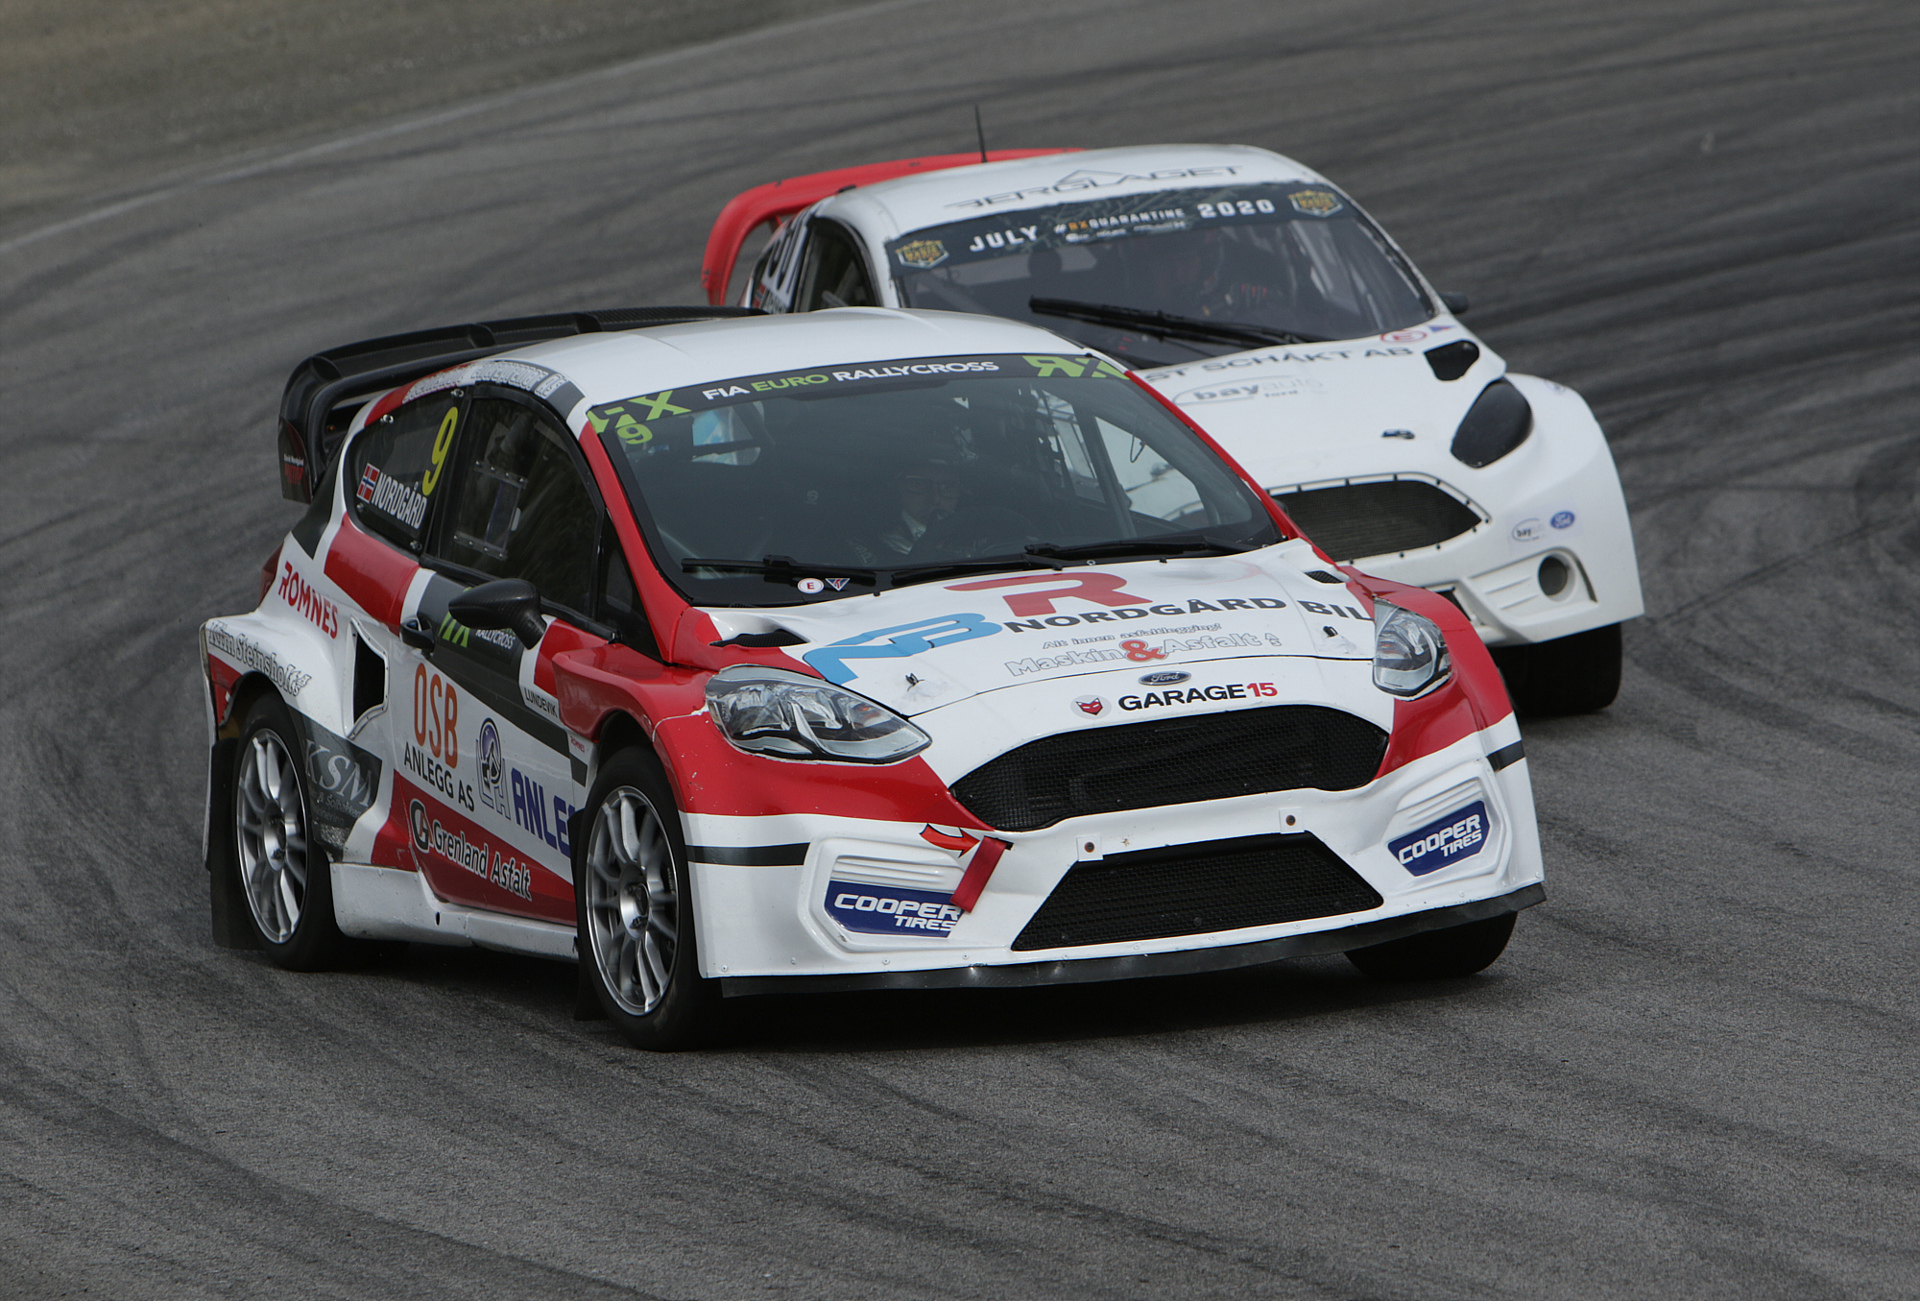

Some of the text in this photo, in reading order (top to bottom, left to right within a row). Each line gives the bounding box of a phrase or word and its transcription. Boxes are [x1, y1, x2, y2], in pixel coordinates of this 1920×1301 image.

[969, 225, 1039, 252] JULY
[1197, 199, 1276, 219] 2020
[1201, 349, 1352, 372] SCHAKT
[1363, 347, 1414, 359] AB
[702, 361, 1000, 400] FIA EURO RALLYCROSS
[422, 406, 458, 496] 9
[617, 423, 653, 445] 9
[371, 473, 428, 530] NORDGÅRD
[278, 560, 339, 640] ROMNES
[807, 581, 816, 590] E
[1002, 598, 1375, 634] NORDGÅRD BIL
[475, 628, 516, 649] RALLYCROSS
[1042, 622, 1222, 649] Alt innen asfaltlegging!
[1151, 671, 1181, 683] Ford
[414, 662, 458, 769] OSB
[523, 687, 558, 718] LUNDEVIK
[306, 739, 369, 808] KSM
[404, 741, 475, 813] ANLEGG AS
[511, 767, 576, 859] ANLE
[1398, 814, 1481, 865] COOPER
[1440, 829, 1482, 857] TIRES
[433, 819, 532, 901] Grenland Asfalt
[834, 893, 961, 921] COOPER
[894, 914, 958, 931] TIRES
